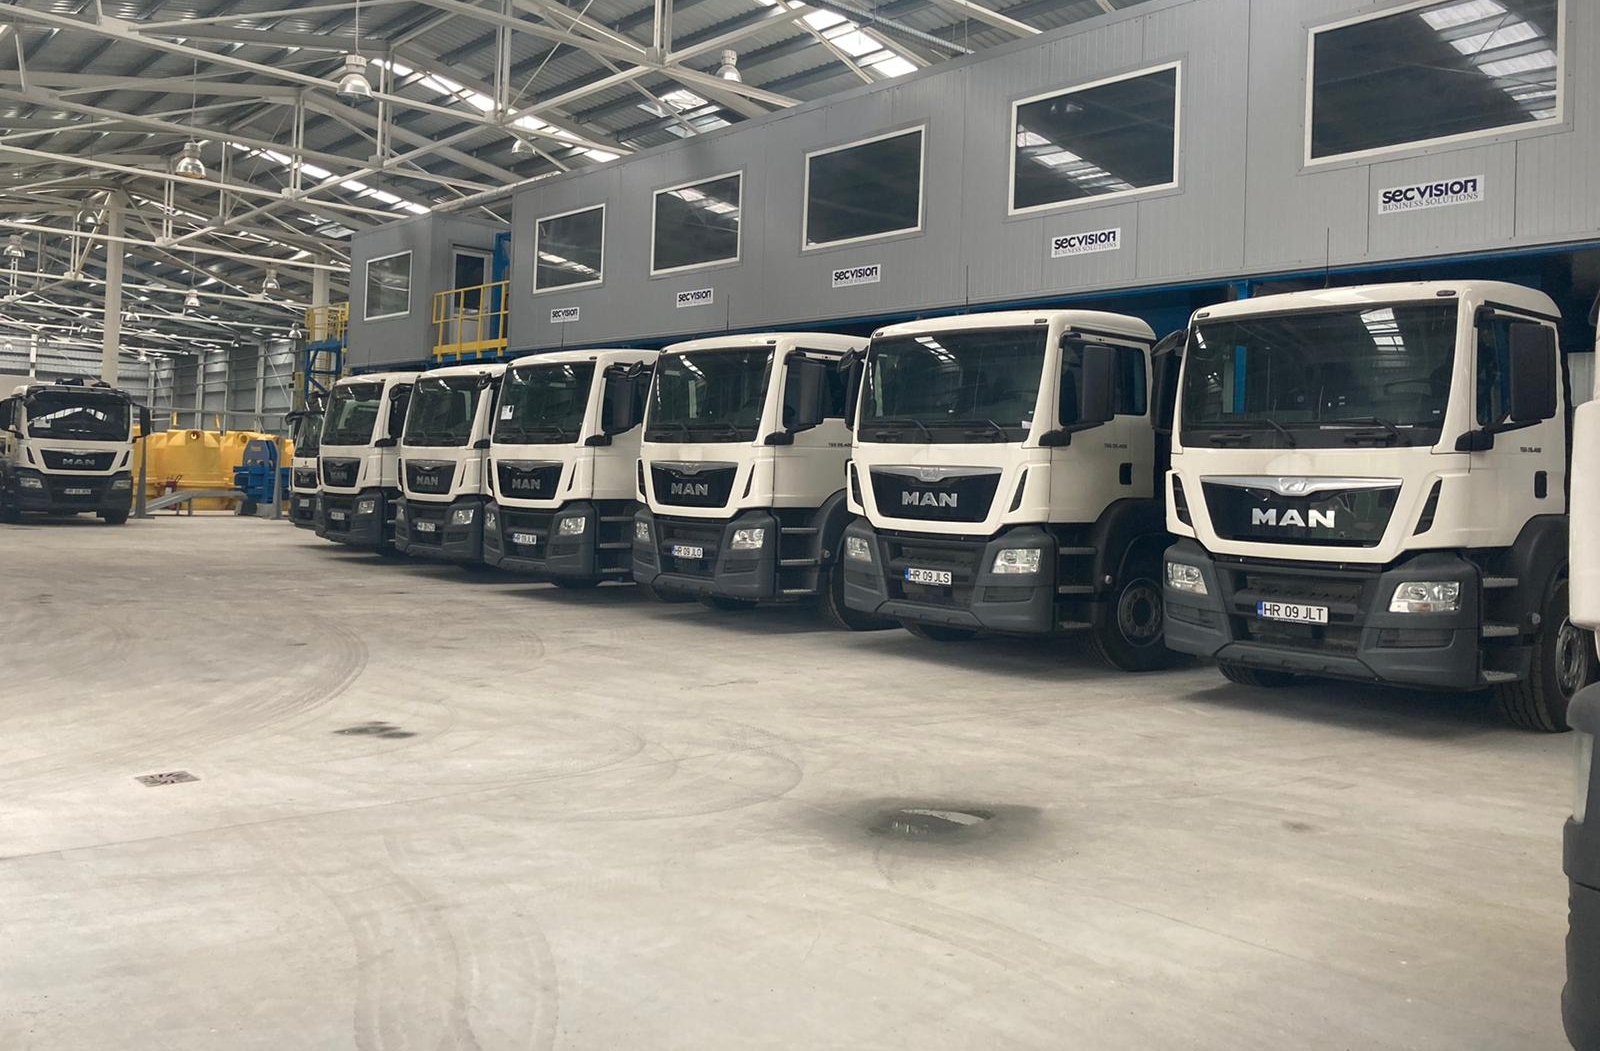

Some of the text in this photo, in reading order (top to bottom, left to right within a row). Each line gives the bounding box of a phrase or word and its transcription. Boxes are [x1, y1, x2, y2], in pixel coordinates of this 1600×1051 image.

[1383, 193, 1479, 212] BUSINESS SOLUTIONS
[62, 458, 95, 466] MAN
[416, 475, 438, 485] MAN
[511, 478, 540, 490] MAN
[671, 482, 709, 496] MAN
[902, 491, 958, 508] MAN
[1252, 507, 1335, 528] MAN
[910, 569, 921, 580] HR
[922, 570, 933, 582] 09
[934, 572, 950, 584] JLS
[1263, 603, 1281, 617] HR
[1284, 605, 1299, 619] 09
[1302, 606, 1324, 621] JLT
